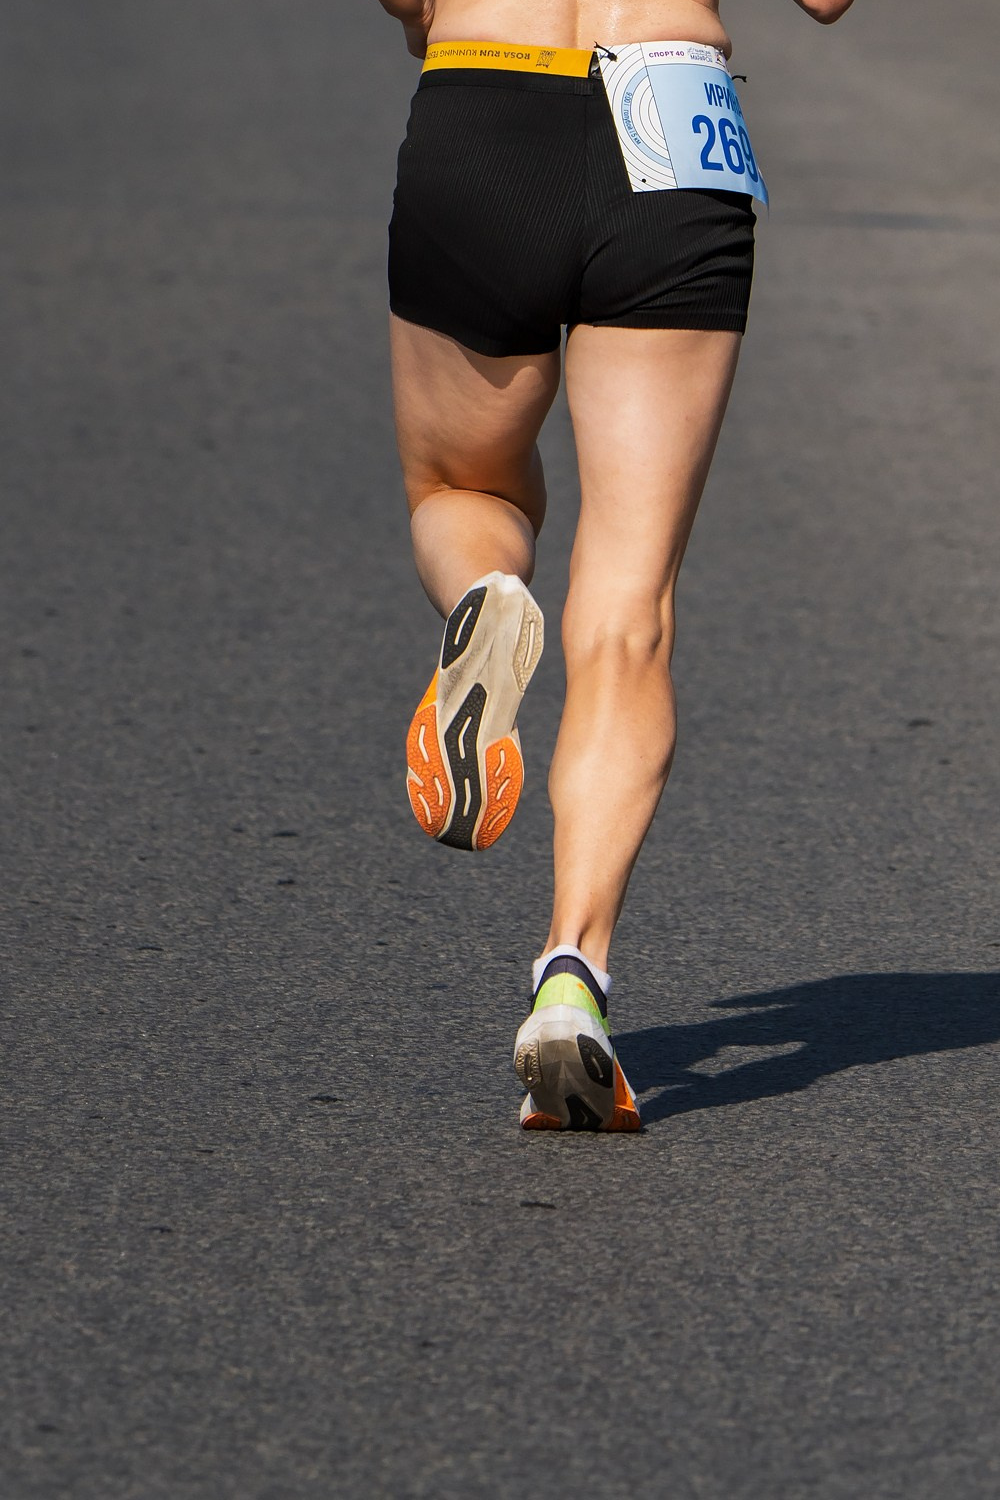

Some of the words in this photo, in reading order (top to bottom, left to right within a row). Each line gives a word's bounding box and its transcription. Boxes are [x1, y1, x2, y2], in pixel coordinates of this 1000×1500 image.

[439, 49, 477, 58] RUNNING
[479, 49, 501, 58] RUN
[503, 51, 531, 60] ROSA
[648, 50, 674, 58] СПОРТ
